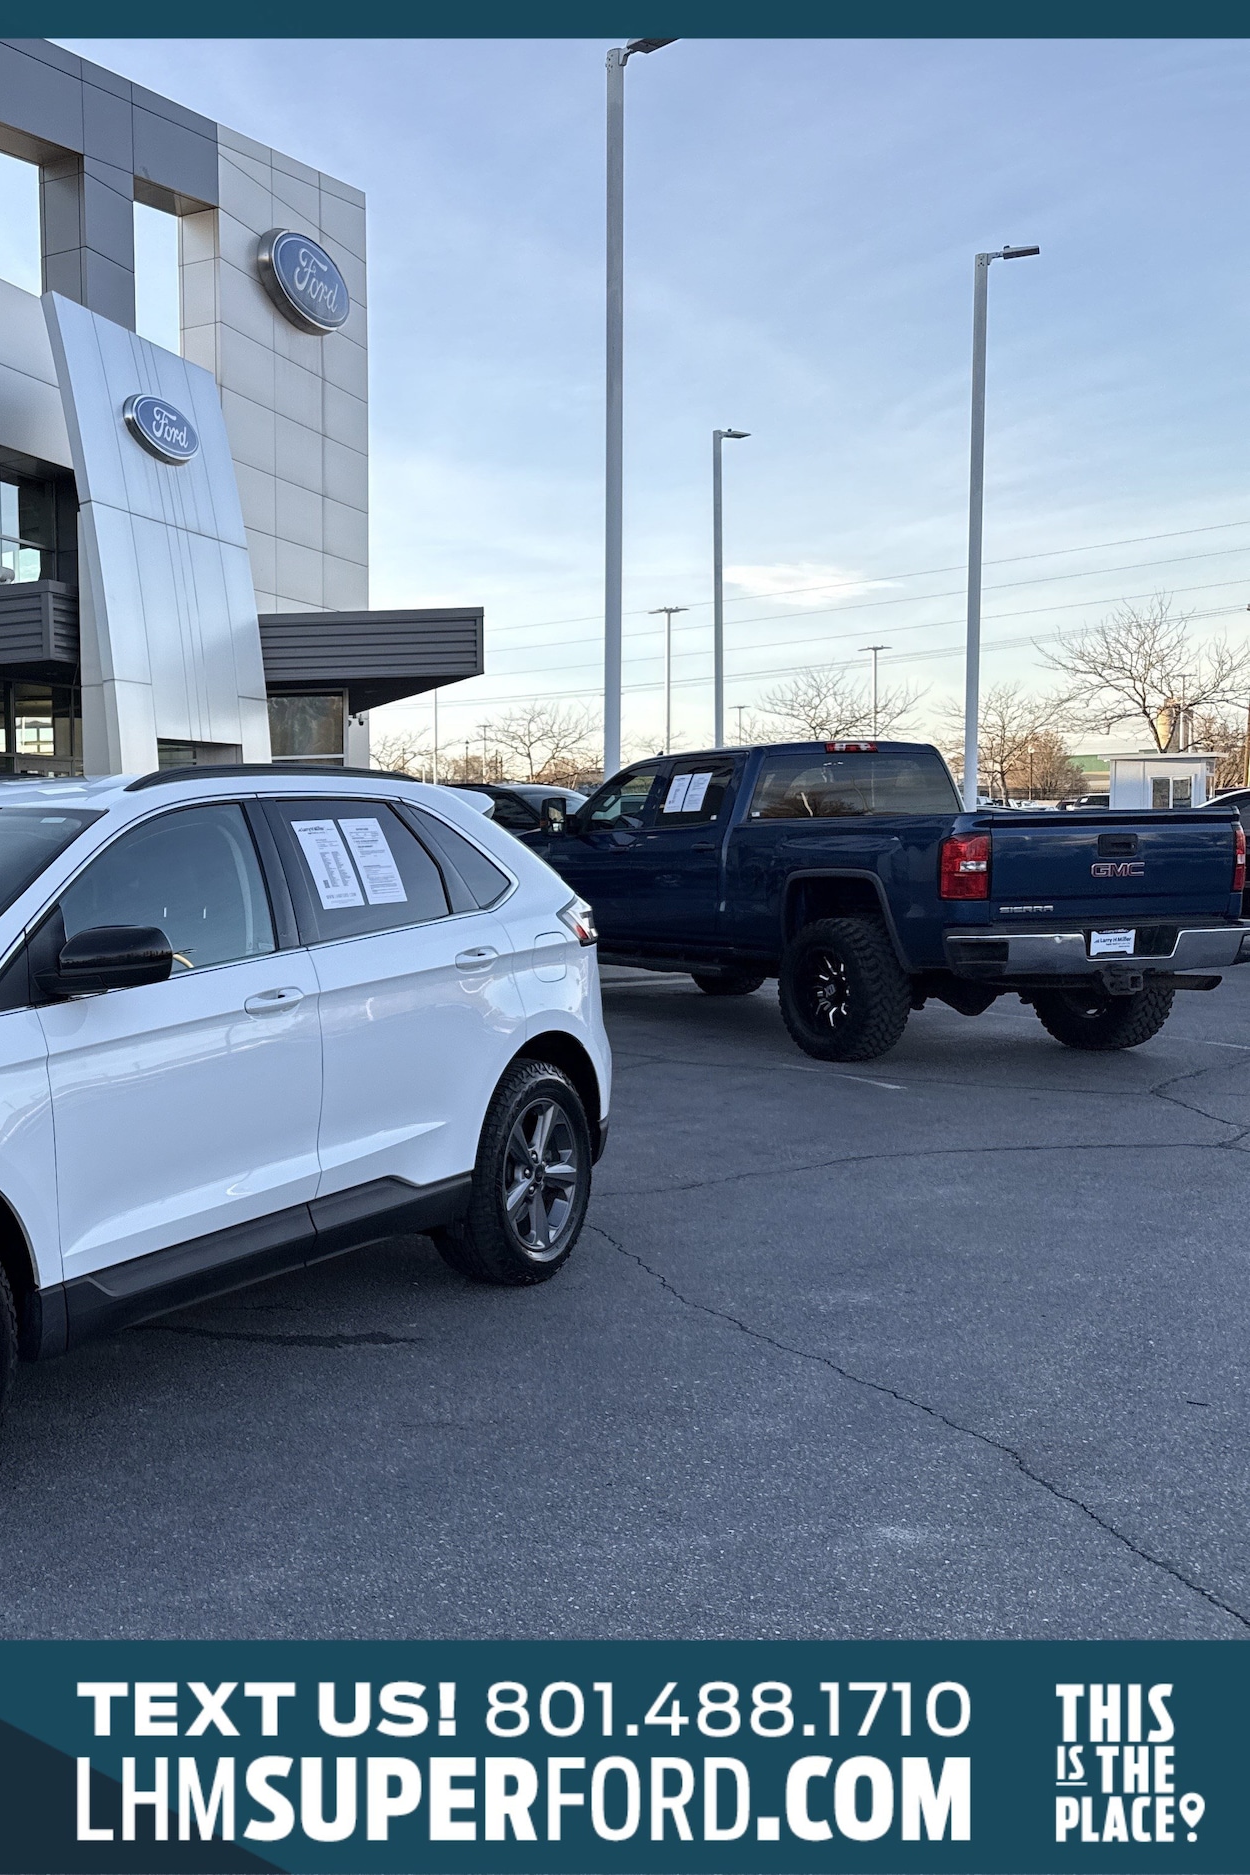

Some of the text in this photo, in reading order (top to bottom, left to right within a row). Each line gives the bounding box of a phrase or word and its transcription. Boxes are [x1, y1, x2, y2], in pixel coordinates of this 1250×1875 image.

[293, 247, 338, 314] Ford
[152, 406, 189, 449] Ford
[1091, 862, 1145, 878] GMC
[999, 905, 1054, 914] SIERRA
